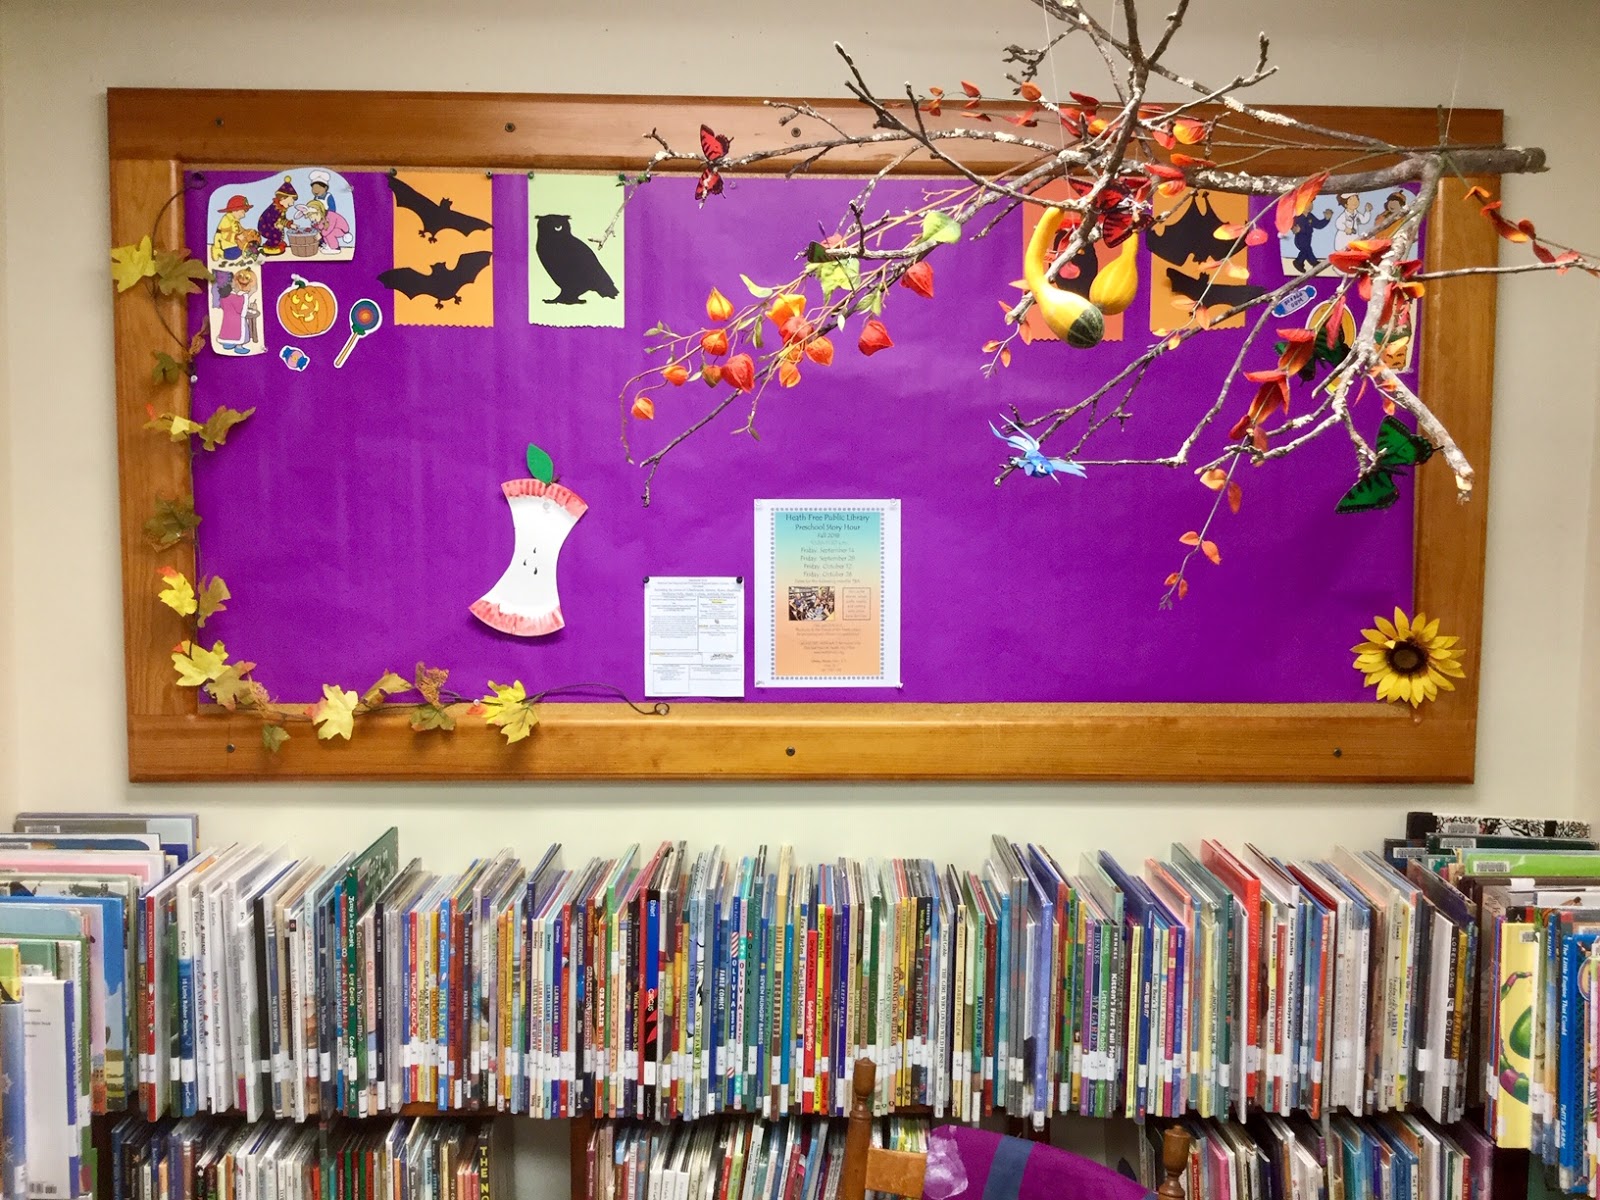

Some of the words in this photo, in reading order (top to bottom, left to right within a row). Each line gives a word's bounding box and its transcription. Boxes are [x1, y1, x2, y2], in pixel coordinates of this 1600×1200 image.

[847, 514, 870, 522] Library
[690, 964, 695, 974] IN
[342, 973, 348, 986] AN
[730, 959, 738, 1008] OLIVIA
[1092, 995, 1098, 1009] MY
[440, 1013, 446, 1022] IS
[696, 1012, 701, 1022] ON
[439, 1024, 446, 1038] ME
[480, 1146, 488, 1178] THE
